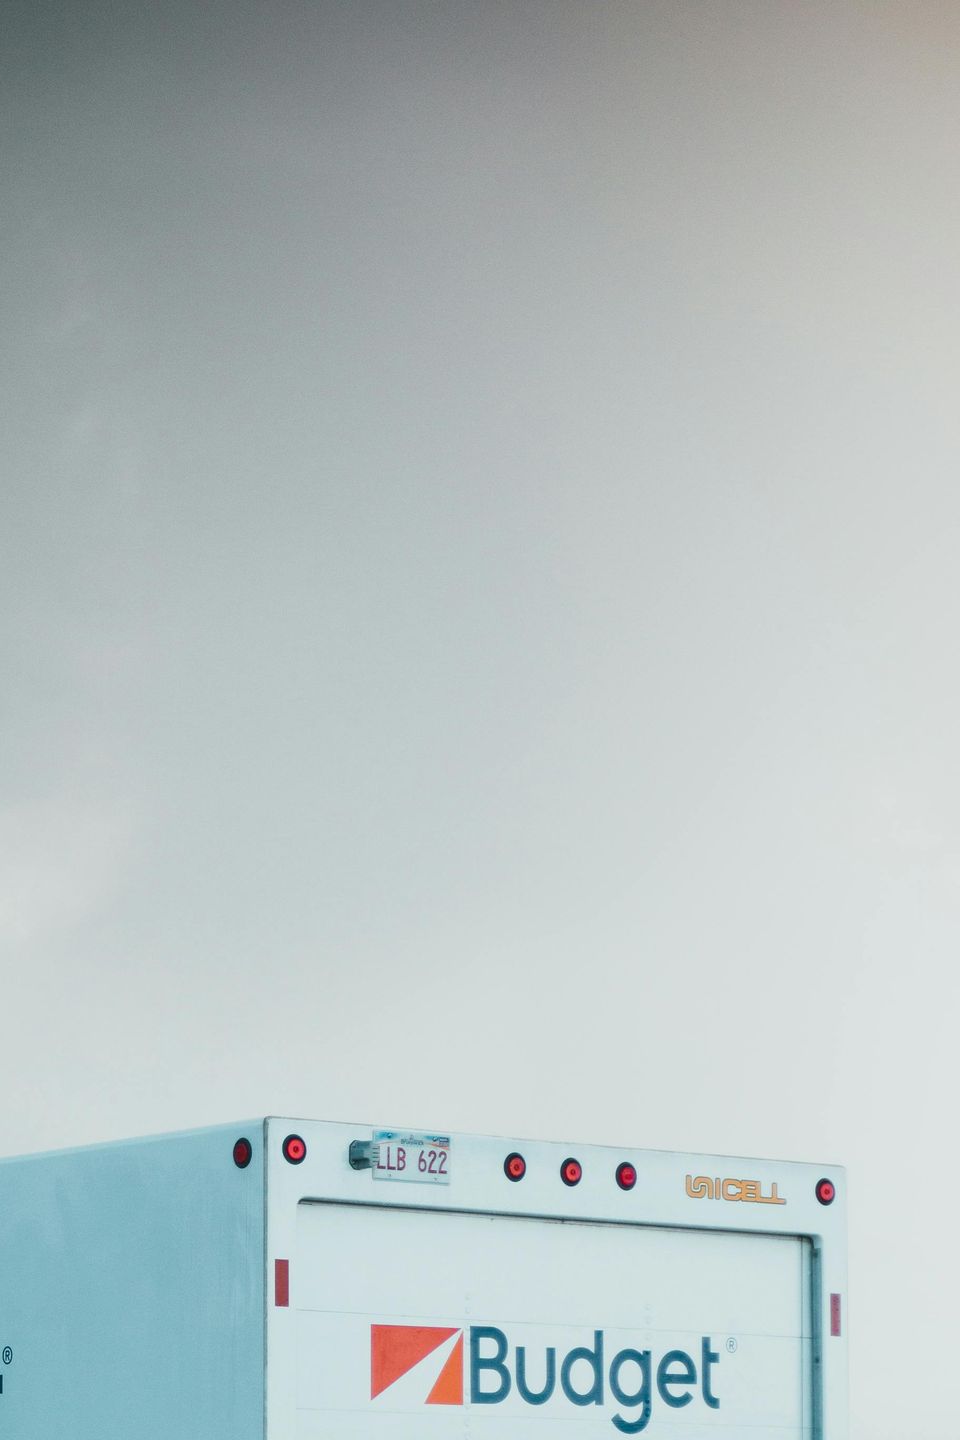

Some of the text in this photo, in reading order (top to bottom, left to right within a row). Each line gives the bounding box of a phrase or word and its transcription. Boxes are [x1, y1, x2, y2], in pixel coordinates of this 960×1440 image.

[418, 1150, 448, 1175] 622
[685, 1174, 787, 1206] UNICELL
[469, 1325, 721, 1435] Budget
